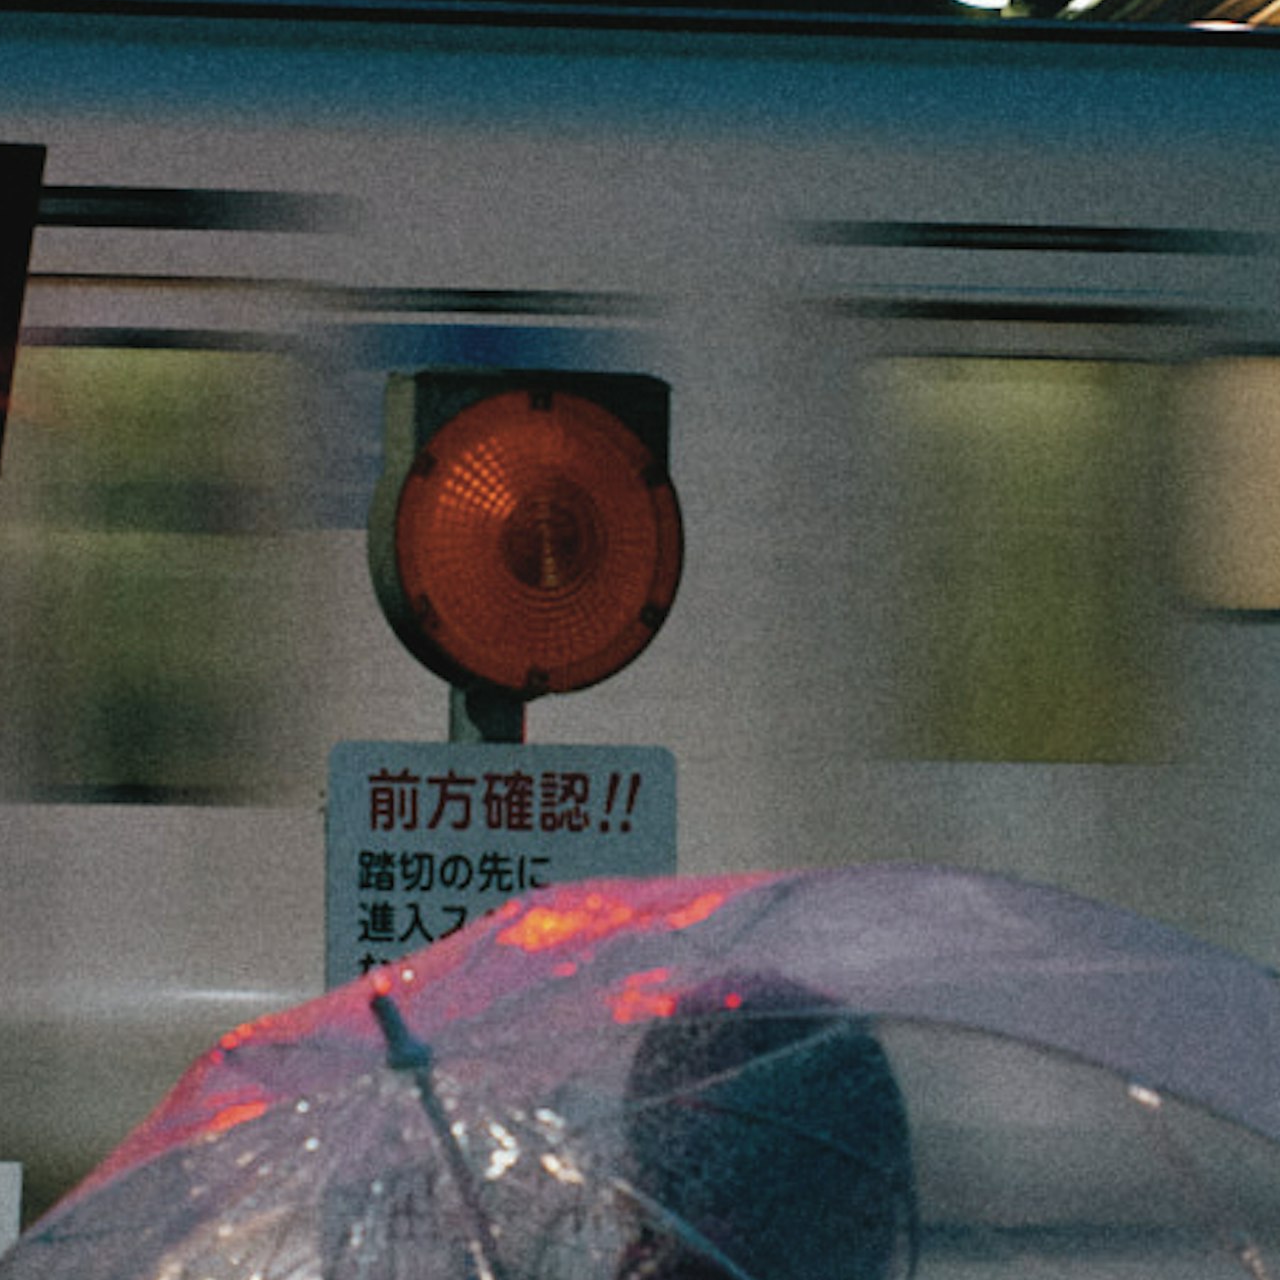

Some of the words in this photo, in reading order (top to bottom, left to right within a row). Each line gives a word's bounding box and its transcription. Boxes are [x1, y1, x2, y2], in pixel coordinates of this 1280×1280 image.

[368, 768, 641, 834] 前方確認!!
[358, 850, 551, 892] 踏切の先に
[358, 900, 495, 943] 進入ス
